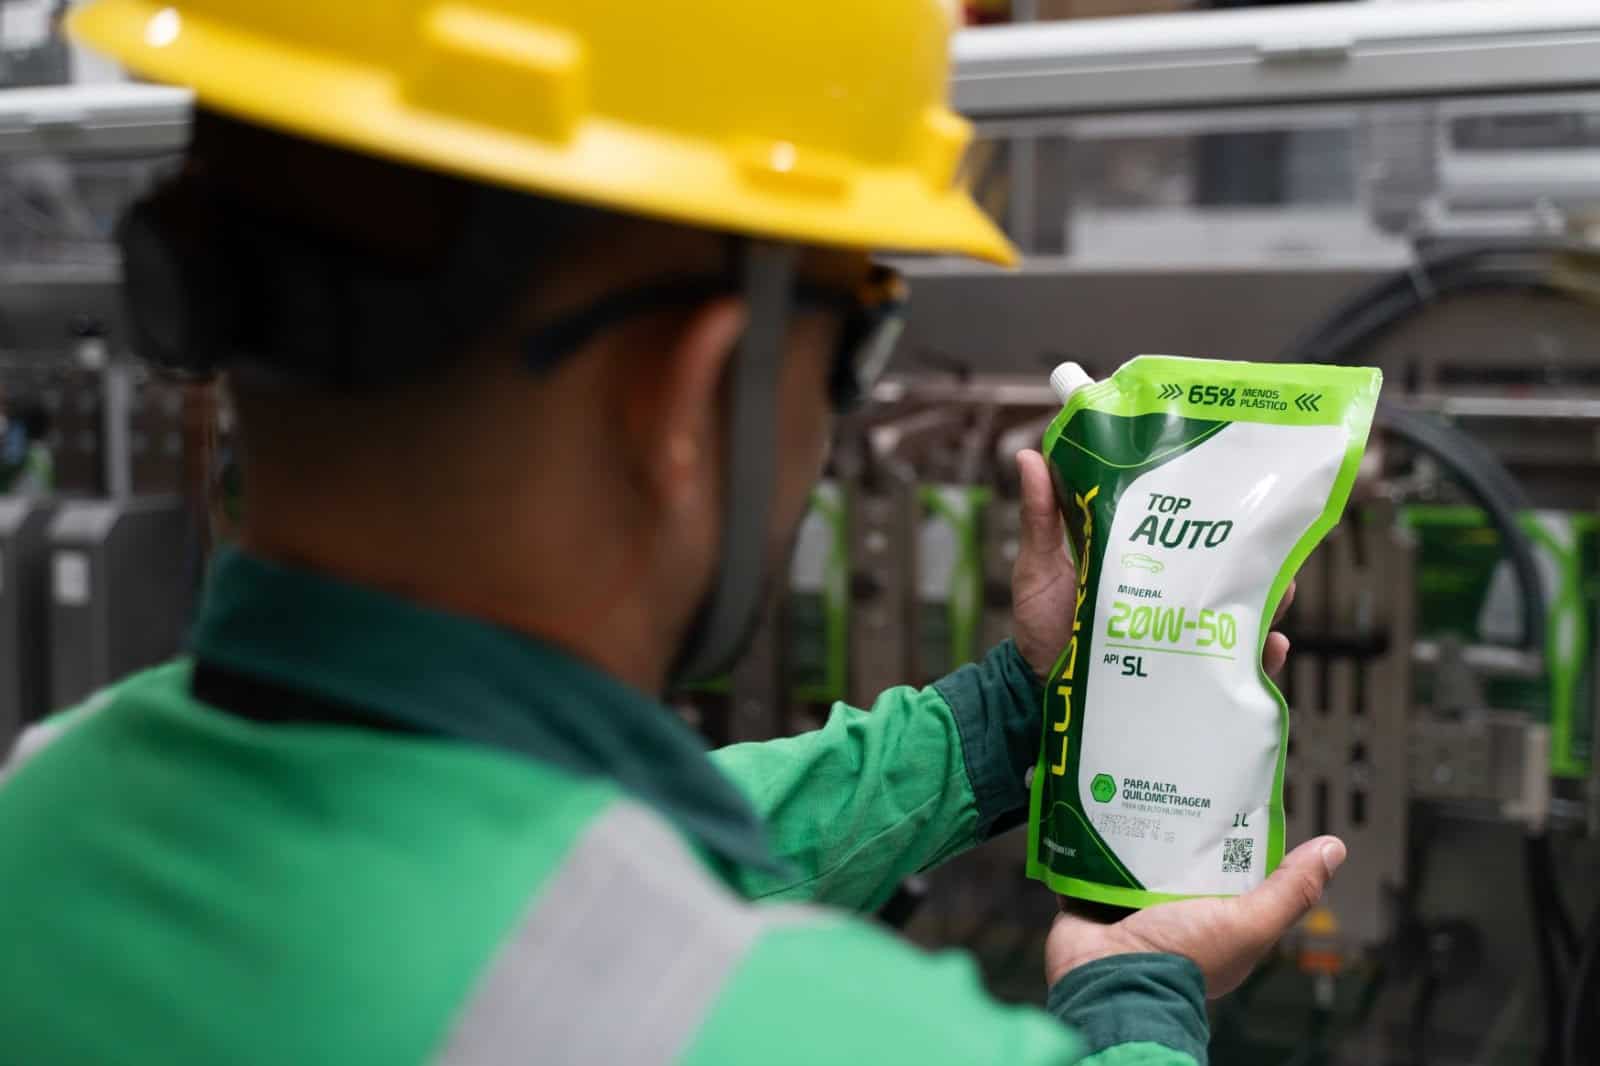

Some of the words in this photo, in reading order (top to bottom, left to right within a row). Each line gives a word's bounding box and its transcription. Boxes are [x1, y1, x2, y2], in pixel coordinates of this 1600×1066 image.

[1188, 384, 1236, 407] 65%
[1241, 388, 1280, 399] MENOS
[1240, 397, 1288, 411] PLÁSTICO
[1147, 492, 1192, 515] TOP
[1128, 514, 1234, 549] AUTO
[1117, 584, 1163, 599] MINERAL
[1106, 601, 1237, 650] 20W-50
[1103, 653, 1120, 665] API
[1121, 655, 1148, 678] SL
[1123, 777, 1150, 790] PARA
[1153, 781, 1177, 793] ALTA
[1122, 789, 1211, 808] QUILOMETRAGEM
[1231, 812, 1249, 828] 1L
